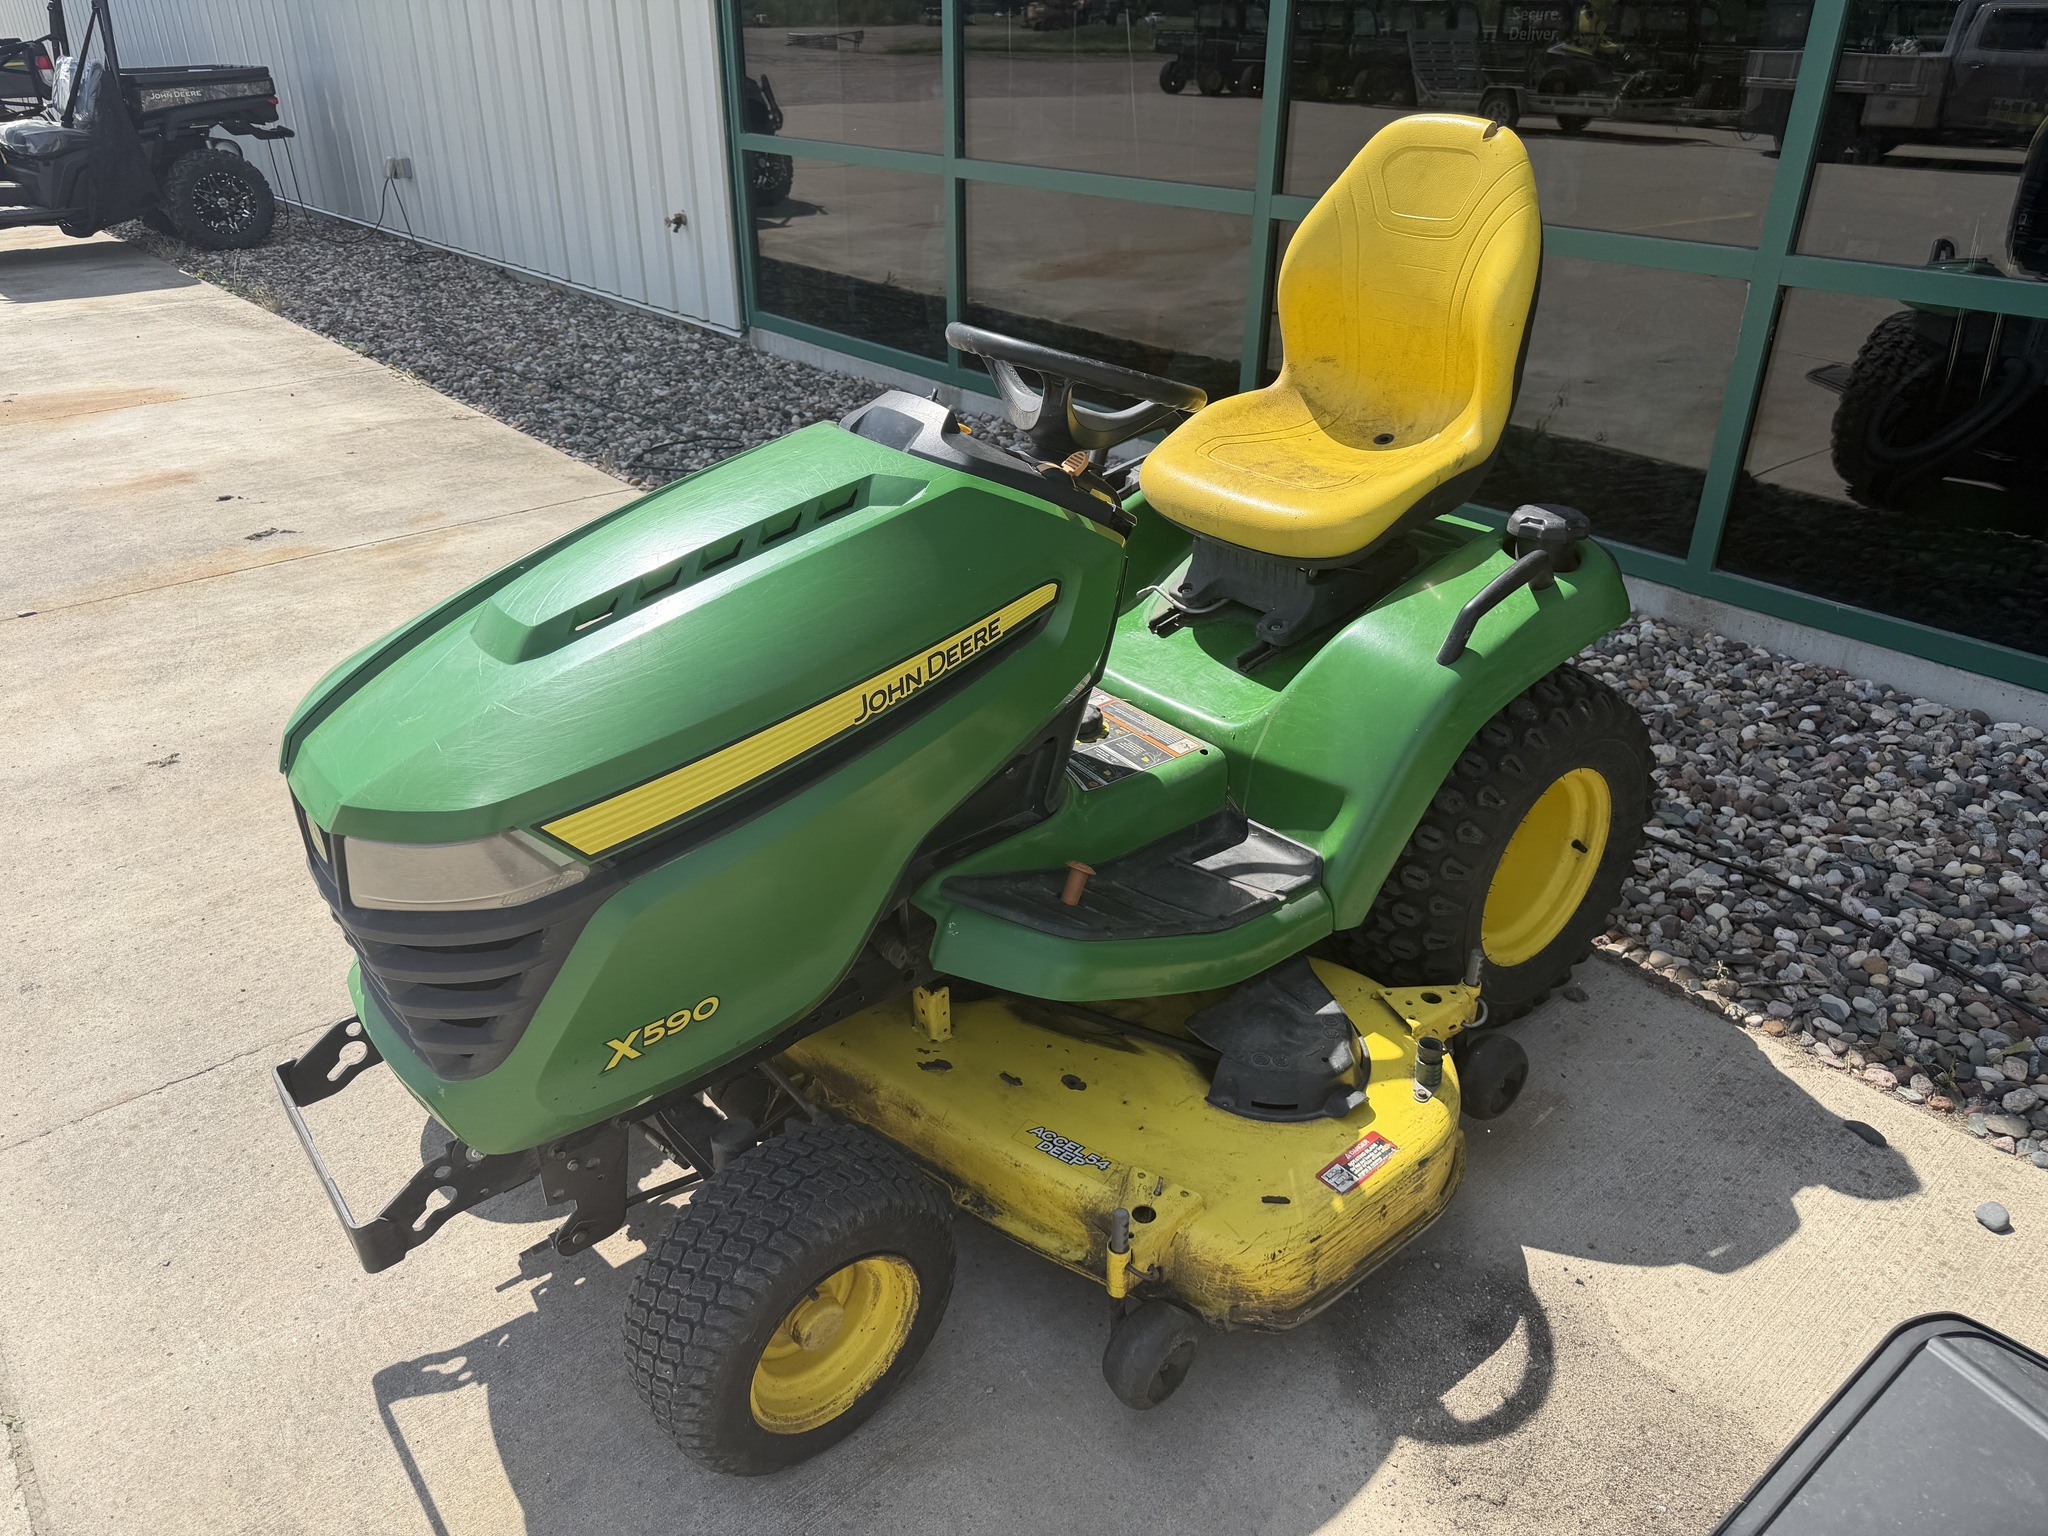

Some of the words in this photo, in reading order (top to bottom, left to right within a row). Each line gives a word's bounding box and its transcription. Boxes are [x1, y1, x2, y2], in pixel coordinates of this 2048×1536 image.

[1512, 6, 1562, 21] Secure.
[1509, 26, 1560, 41] Deliver.
[150, 92, 173, 100] JOHN
[174, 90, 202, 98] DEERE
[853, 666, 923, 724] JOHN
[927, 616, 1003, 681] DEERE
[600, 996, 721, 1075] X590
[1026, 1126, 1086, 1158] ACCEL
[1085, 1153, 1112, 1171] 54
[1035, 1140, 1087, 1166] DEEP
[1349, 1138, 1370, 1157] DANGER
